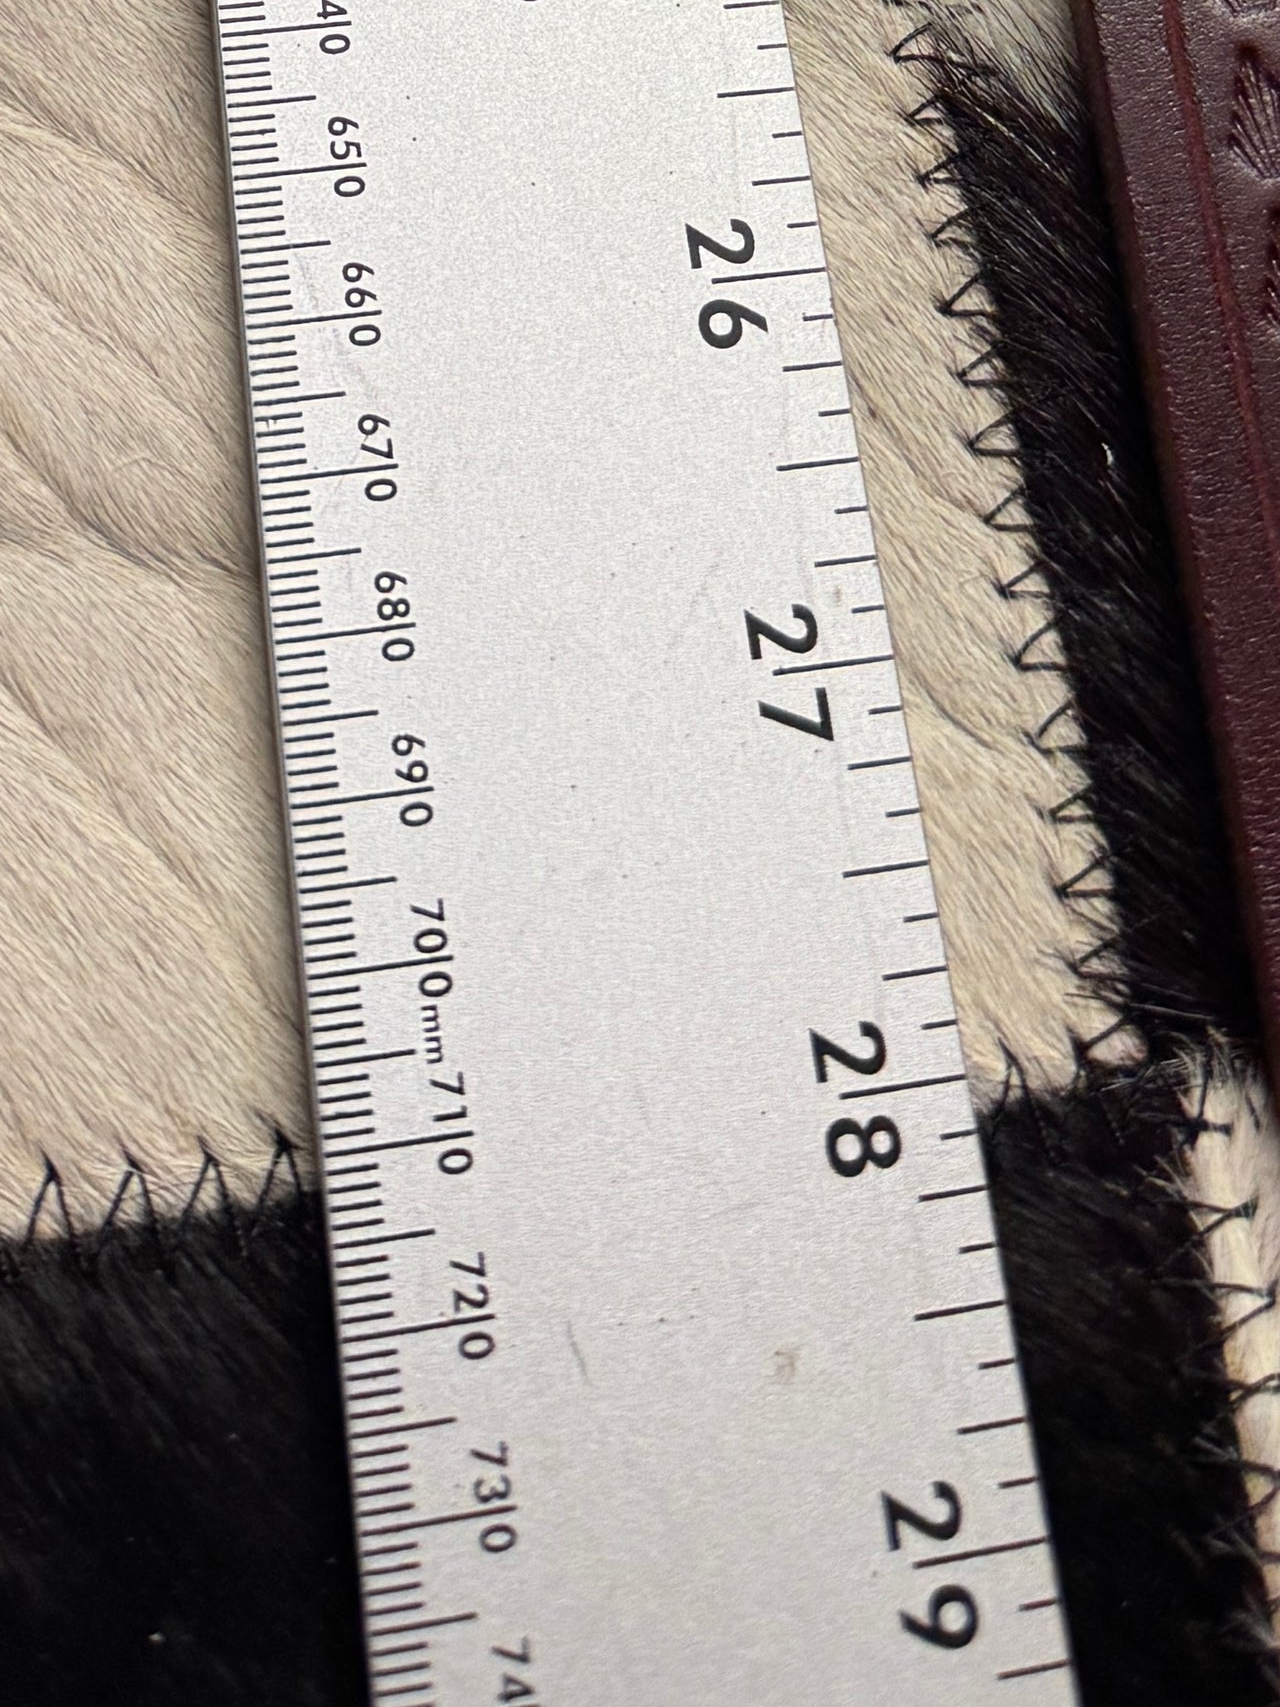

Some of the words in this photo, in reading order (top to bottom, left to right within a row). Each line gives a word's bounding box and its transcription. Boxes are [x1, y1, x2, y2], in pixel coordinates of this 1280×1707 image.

[327, 117, 366, 198] 650
[343, 263, 380, 347] 660
[359, 414, 397, 502] 670
[375, 571, 415, 662] 680
[392, 735, 432, 827] 690
[686, 219, 767, 351] 26
[744, 604, 834, 743] 27
[810, 1021, 901, 1176] 28
[880, 1482, 977, 1651] 29
[428, 1073, 472, 1175] 710
[451, 1252, 494, 1359] 720
[469, 1443, 514, 1552] 730
[492, 1635, 536, 1706] 74
